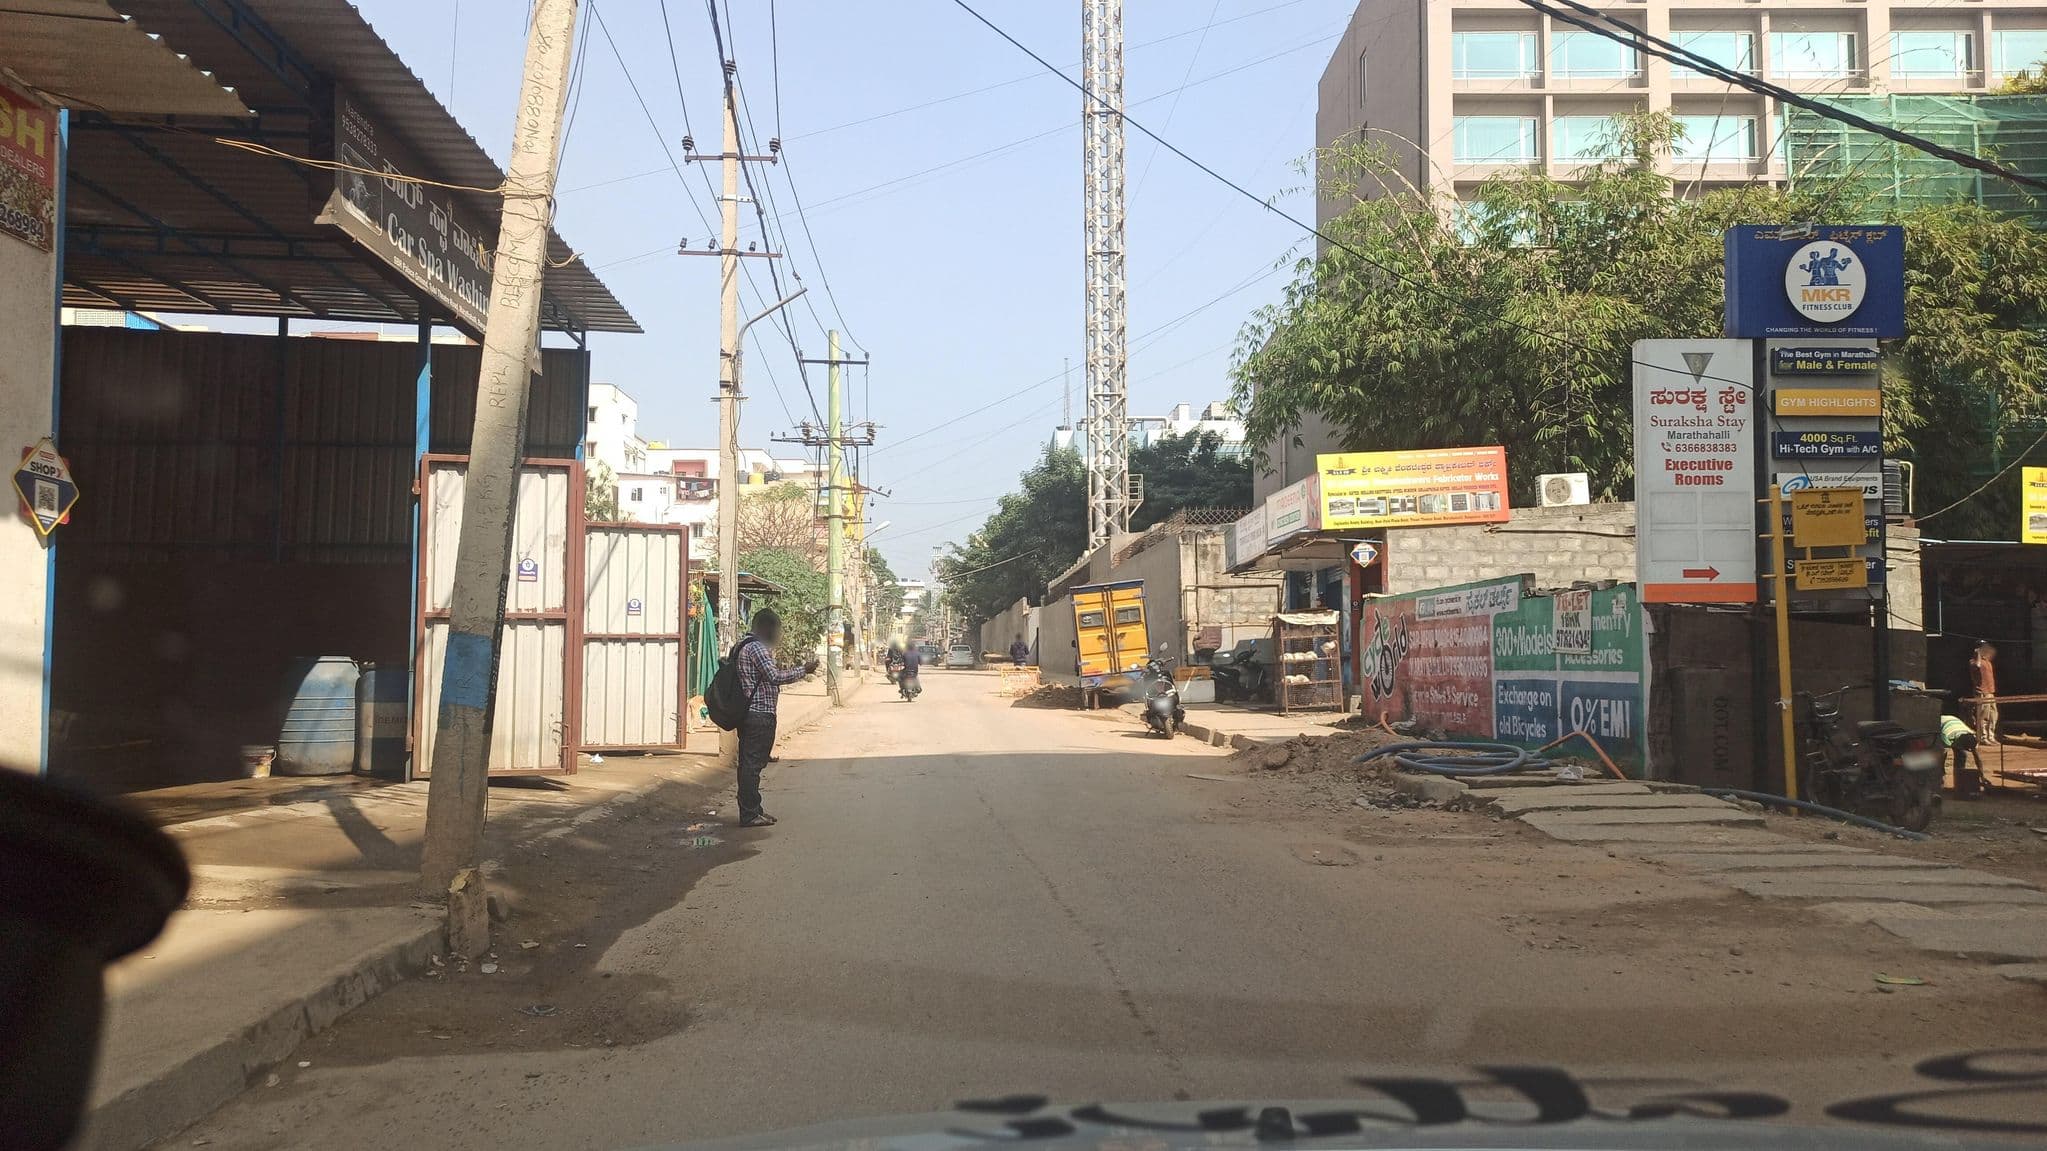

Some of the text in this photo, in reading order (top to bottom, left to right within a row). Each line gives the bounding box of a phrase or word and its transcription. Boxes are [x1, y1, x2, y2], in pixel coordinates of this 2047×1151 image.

[388, 213, 415, 257] Car
[419, 237, 443, 283] Spa
[447, 258, 490, 318] Washin
[1801, 288, 1851, 302] MKR
[1814, 351, 1832, 359] Gym
[1796, 360, 1823, 370] Male
[1825, 360, 1834, 370] &
[1837, 360, 1878, 370] Female
[1780, 397, 1877, 408] GYM HIGHLIGHTS
[1650, 415, 1746, 432] Suraksha Stay
[1667, 430, 1731, 440] Marathahalli
[1800, 433, 1828, 443] 4000
[1675, 443, 1737, 453] 6366838383
[1779, 444, 1878, 456] Hi-Tech Gym with A/C
[1665, 459, 1733, 471] Executive
[1675, 473, 1724, 486] Rooms
[1844, 475, 1878, 483] Equipments
[1498, 685, 1552, 711] Exchange on
[1499, 715, 1547, 742] old Bicycles
